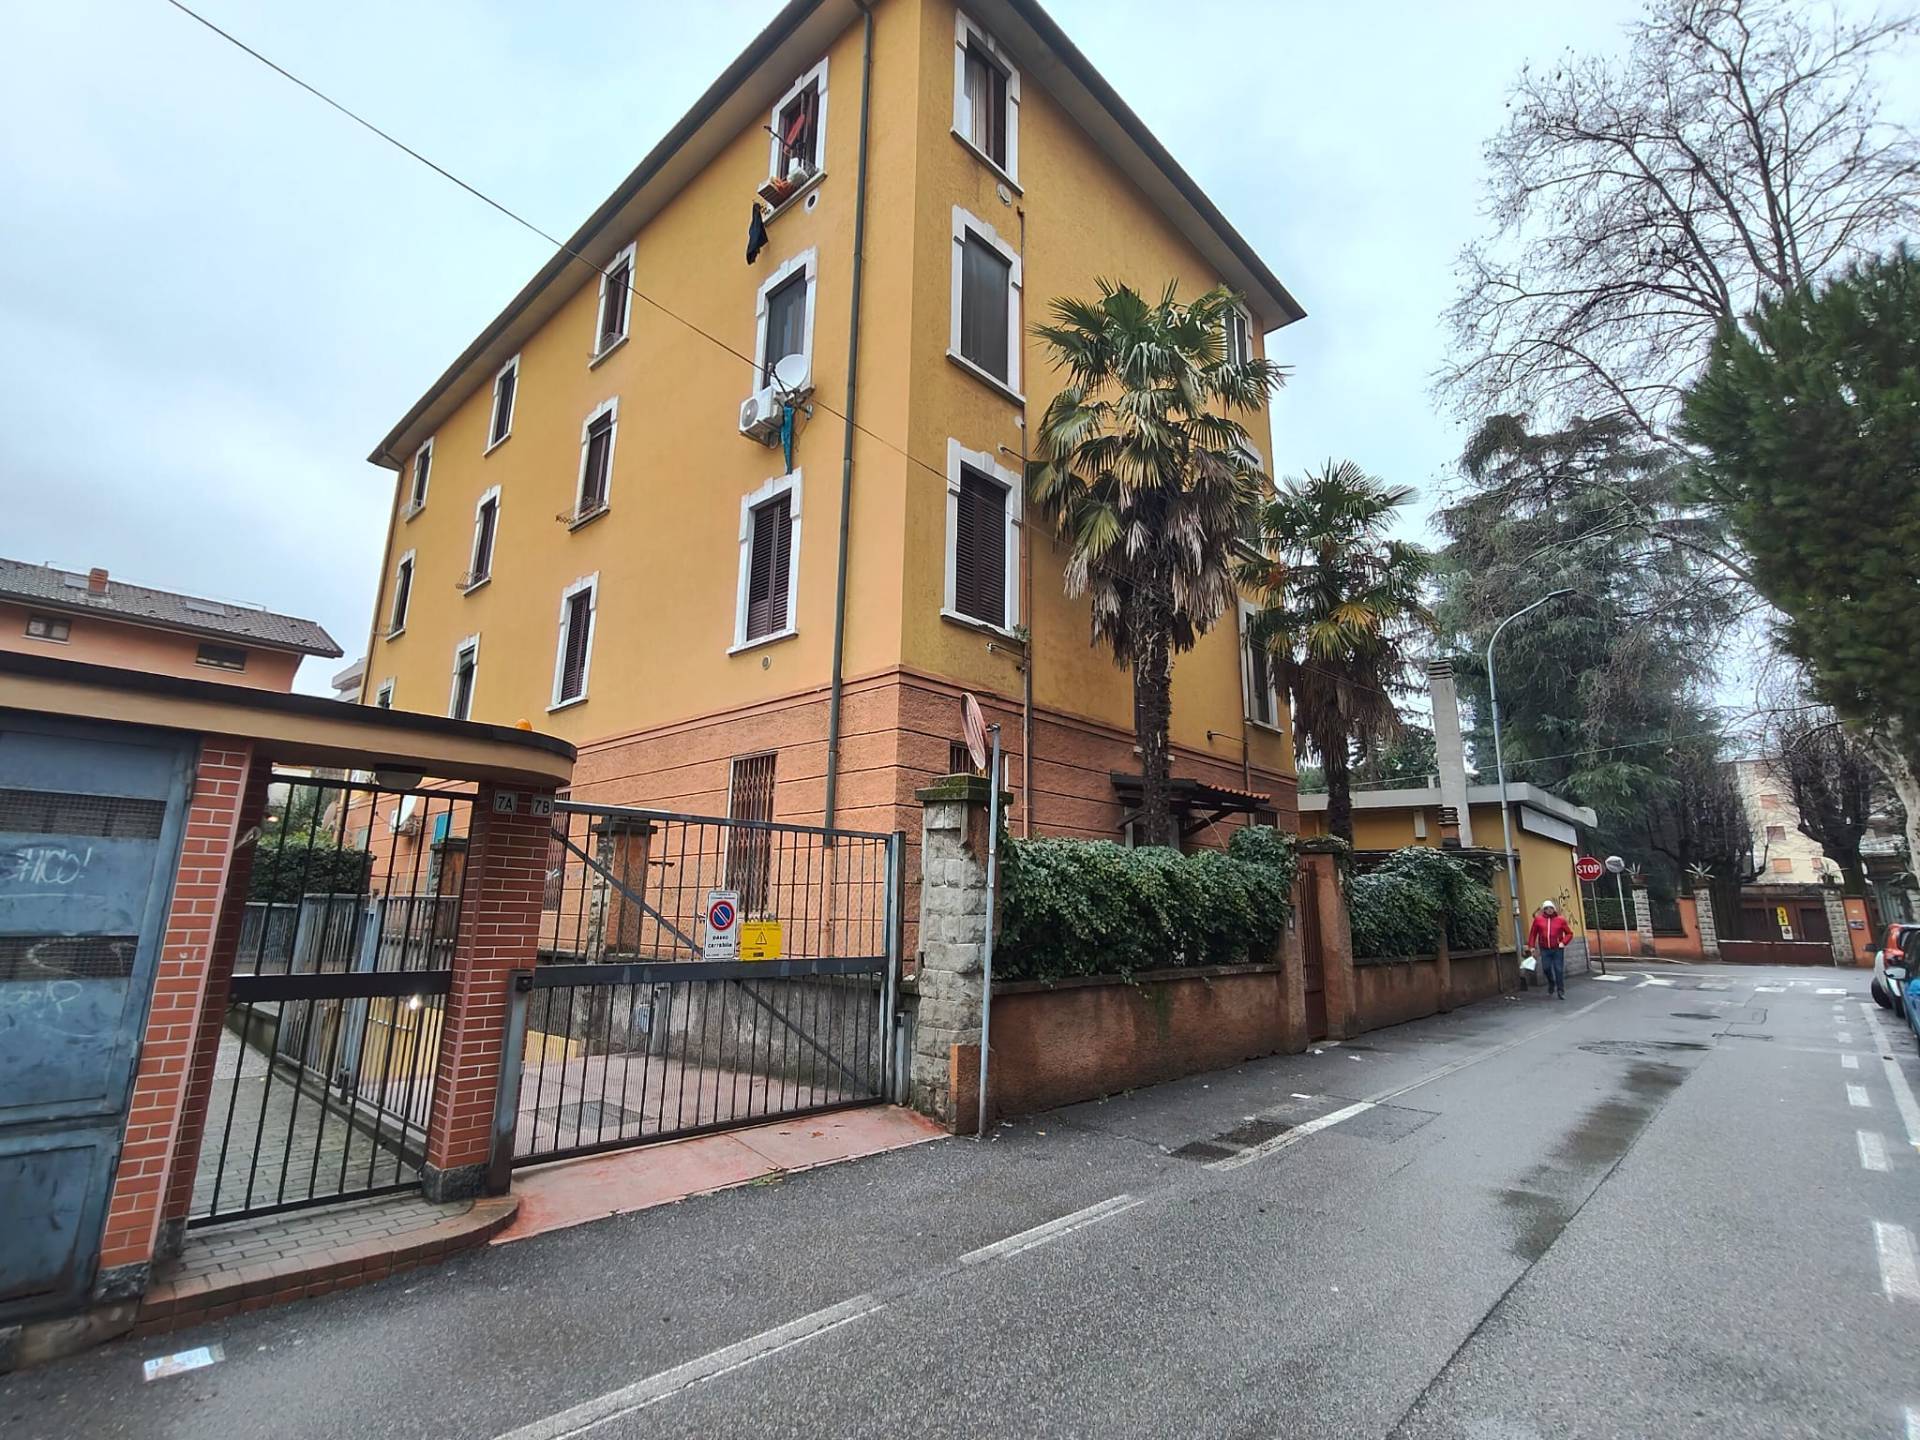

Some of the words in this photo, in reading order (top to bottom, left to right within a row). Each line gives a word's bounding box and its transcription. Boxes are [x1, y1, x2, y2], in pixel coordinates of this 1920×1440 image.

[498, 796, 513, 811] 7A
[535, 799, 550, 814] 7B
[1576, 864, 1600, 874] STOP
[708, 941, 732, 949] carrabile
